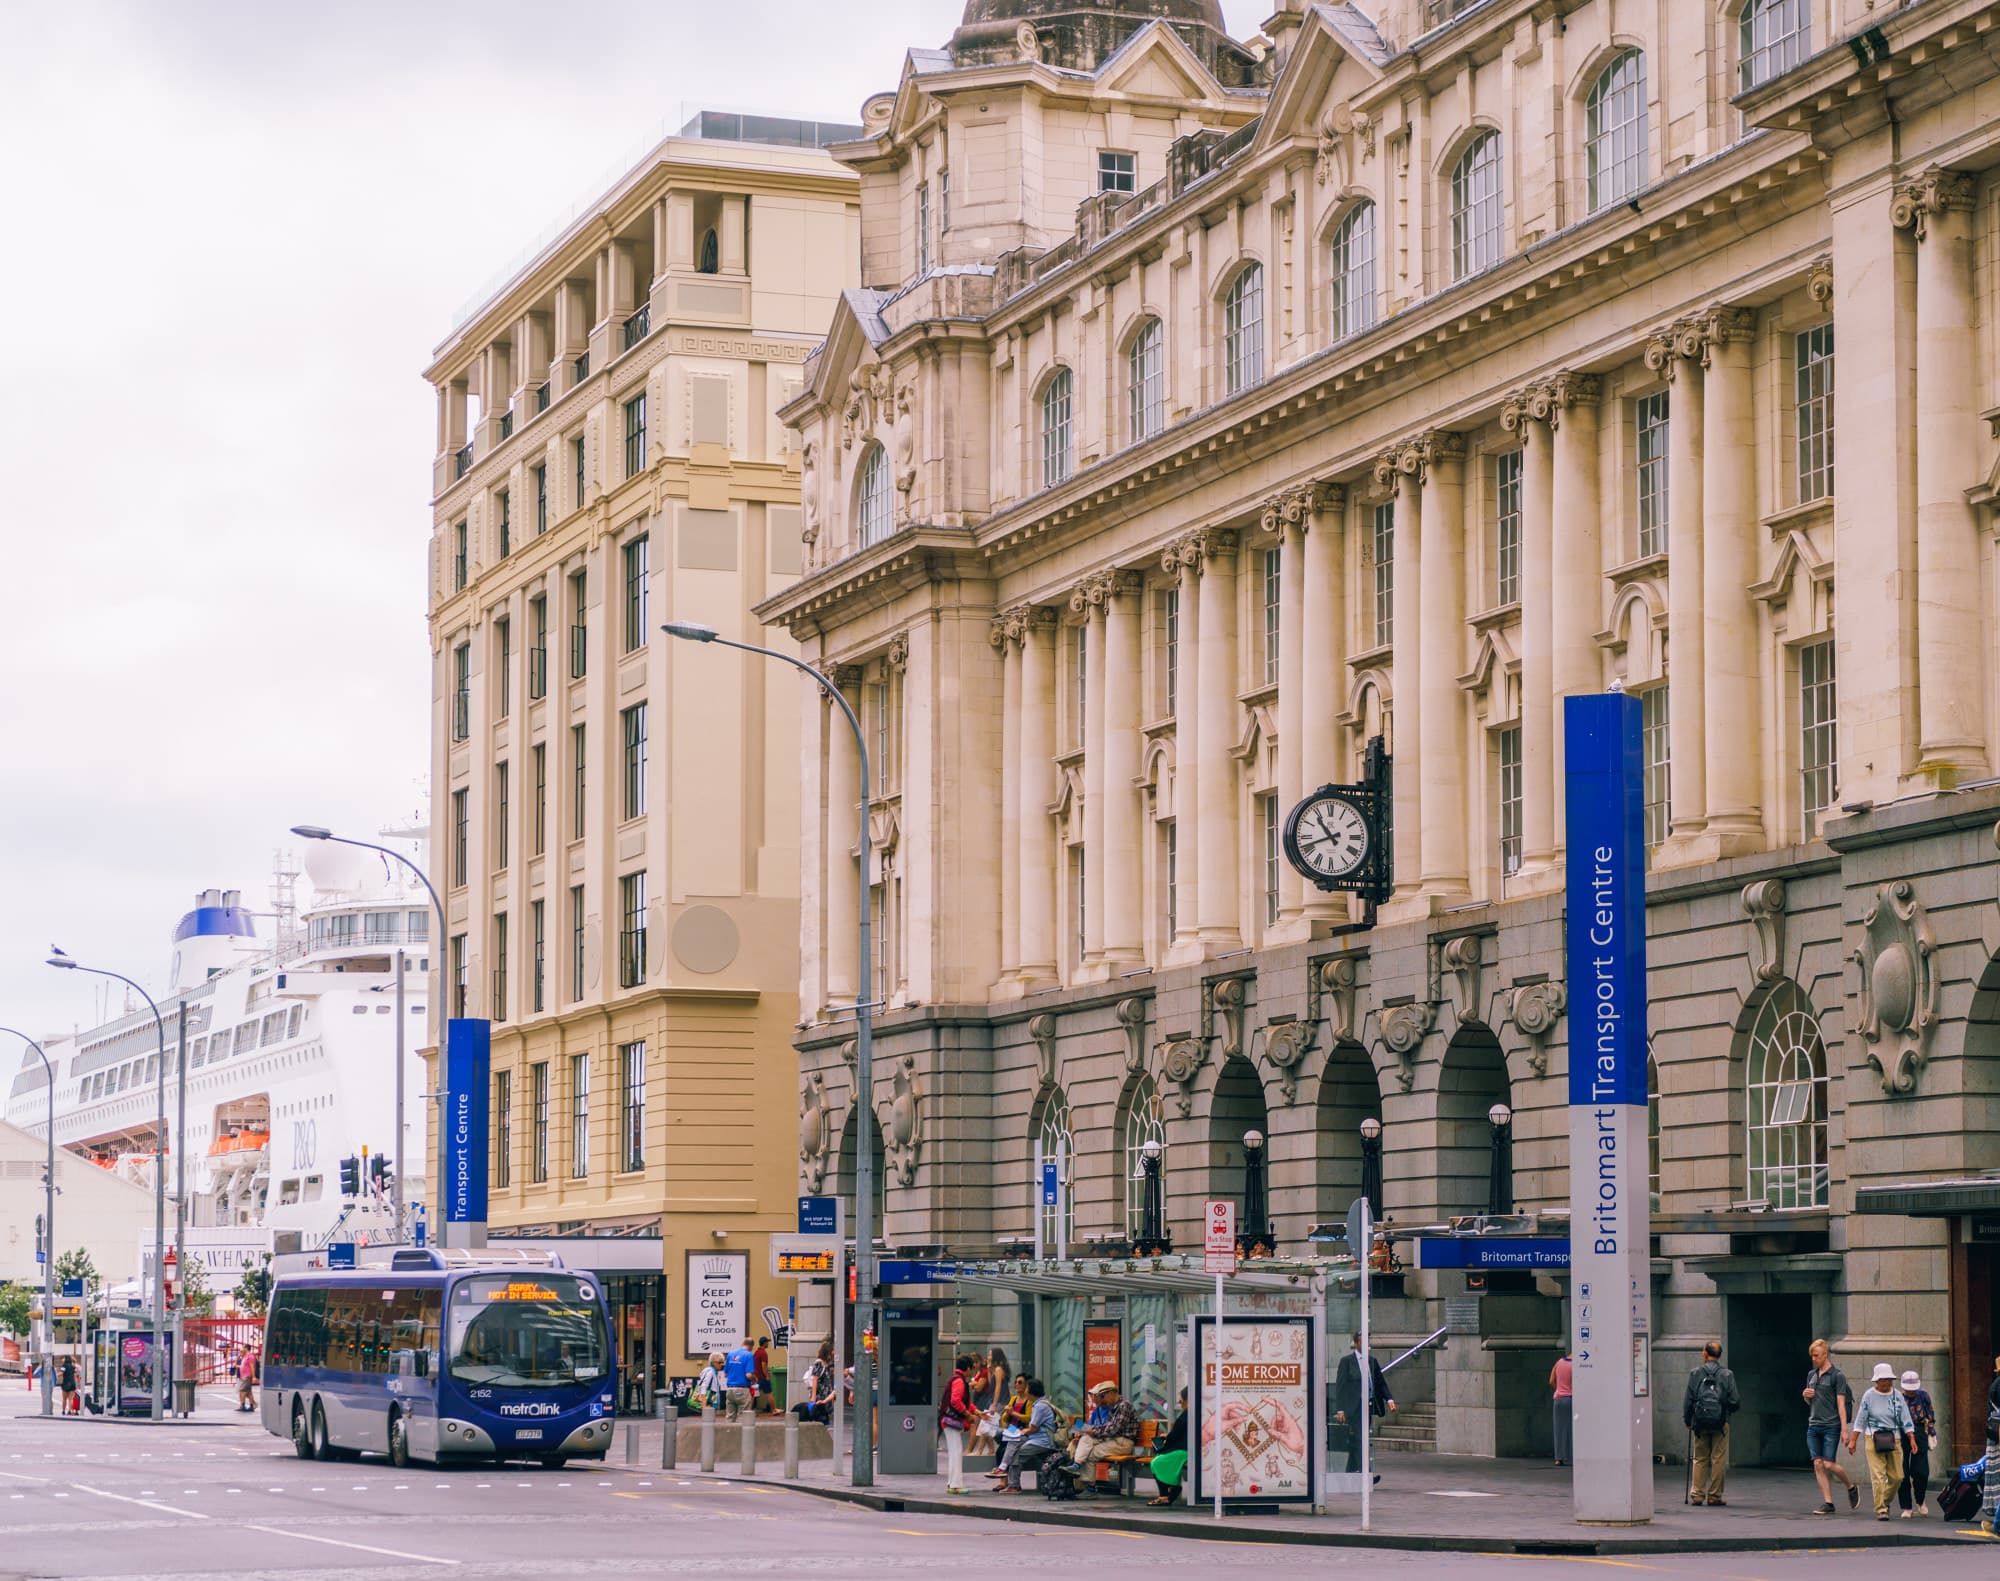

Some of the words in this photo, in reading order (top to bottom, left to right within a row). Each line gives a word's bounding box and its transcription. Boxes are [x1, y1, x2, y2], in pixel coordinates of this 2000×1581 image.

[1590, 846, 1614, 946] Centre
[1592, 955, 1621, 1102] Transport
[456, 1093, 468, 1144] Centre
[292, 1118, 317, 1171] P&O
[455, 1148, 470, 1221] Transport
[1594, 1108, 1617, 1254] Britomart
[1481, 1252, 1532, 1262] Britomart
[488, 1291, 507, 1299] NOT
[509, 1291, 519, 1299] IN
[521, 1291, 557, 1299] SERVICE
[702, 1288, 733, 1297] KEEP
[701, 1299, 734, 1309] CALM
[707, 1318, 727, 1326] EAT
[1210, 1366, 1250, 1379] HOME
[1254, 1366, 1298, 1379] FRONT
[470, 1390, 491, 1398] 2152
[500, 1404, 560, 1416] metrolink
[1278, 1480, 1292, 1488] AM
